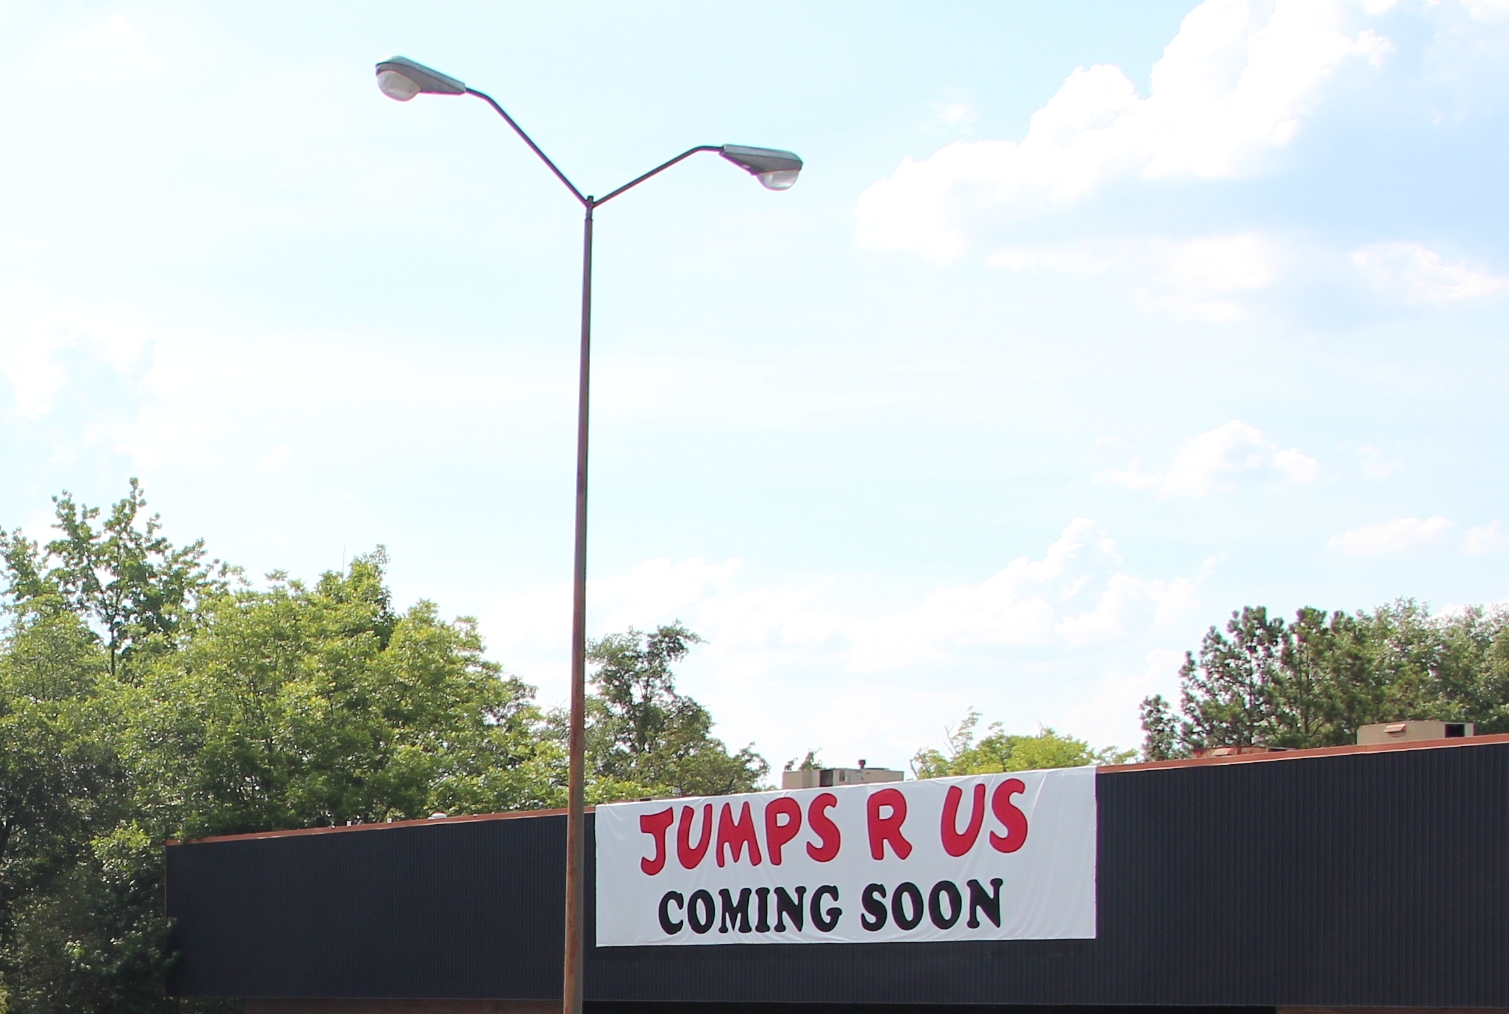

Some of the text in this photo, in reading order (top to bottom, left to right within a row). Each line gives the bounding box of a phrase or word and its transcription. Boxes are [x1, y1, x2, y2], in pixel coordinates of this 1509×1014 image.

[640, 778, 1028, 876] JUMPS R US
[658, 877, 1004, 936] COMING SOON
